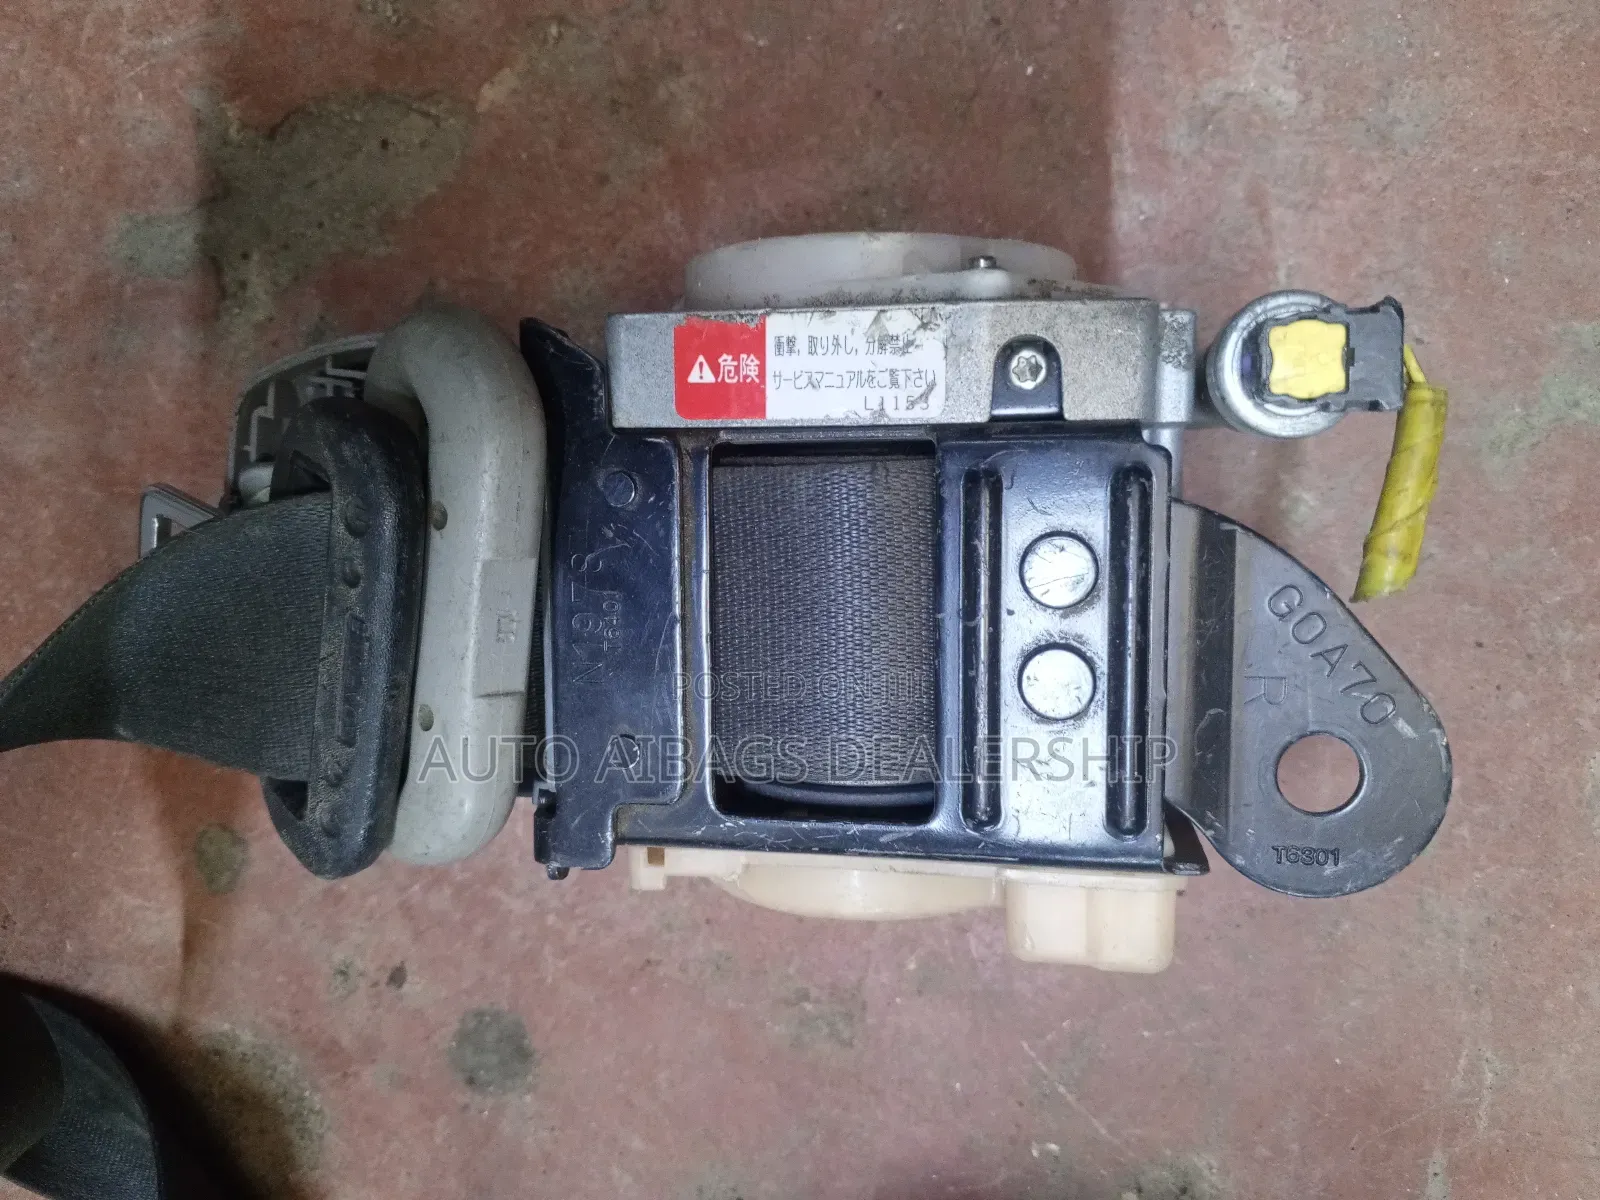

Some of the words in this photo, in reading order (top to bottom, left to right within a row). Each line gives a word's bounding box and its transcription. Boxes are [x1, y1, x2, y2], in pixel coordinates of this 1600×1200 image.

[717, 353, 761, 384] 危険
[772, 368, 937, 390] サービスマニュアルをご覧下さい
[1243, 675, 1288, 706] R
[1271, 845, 1341, 866] T6301
